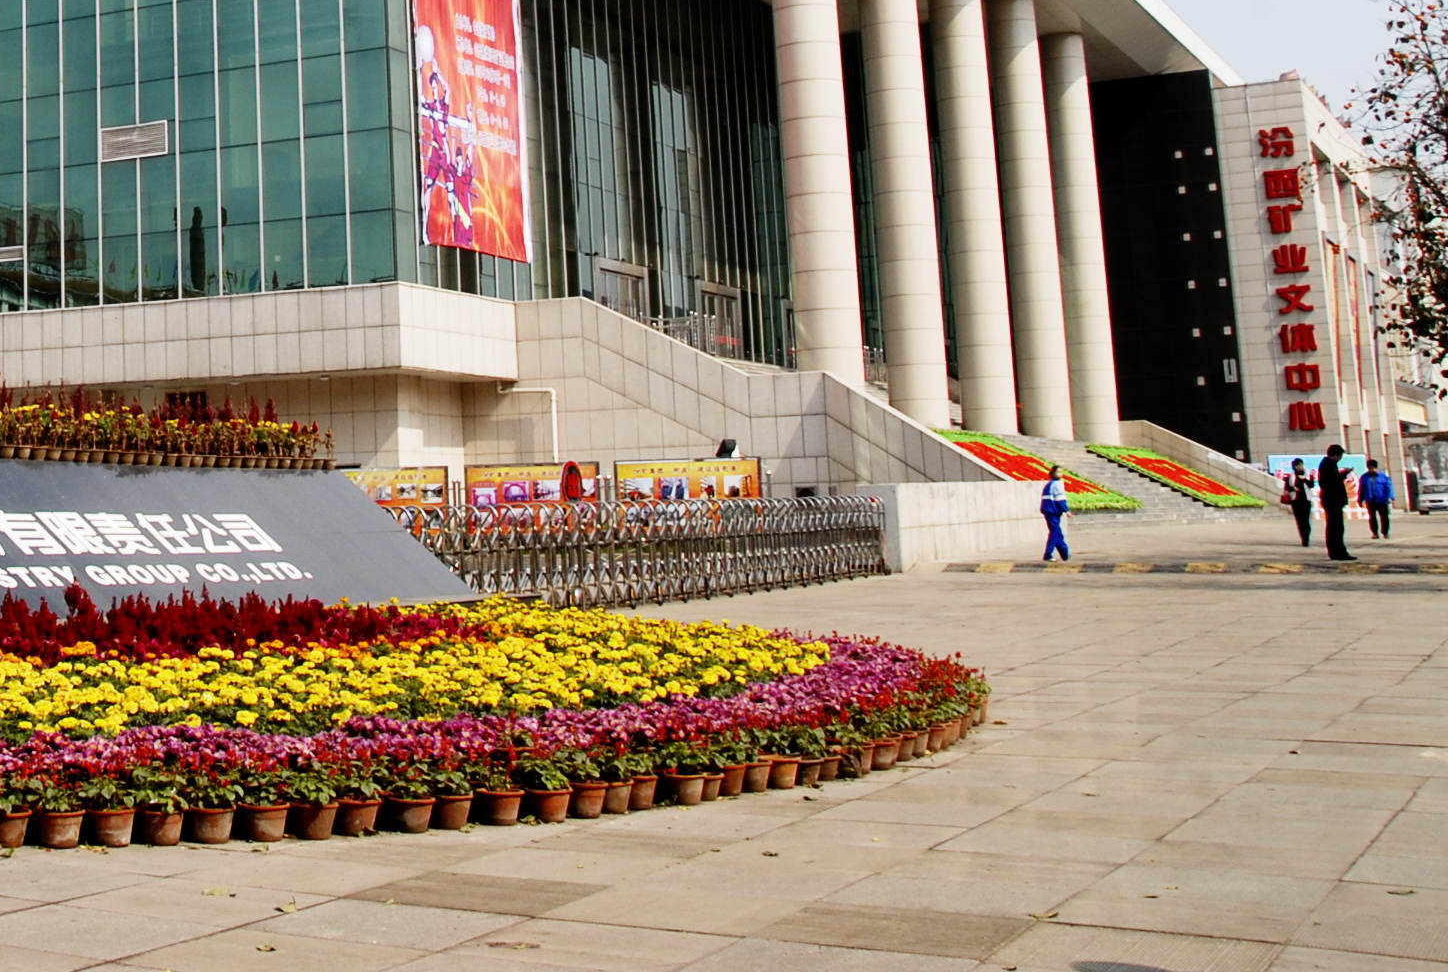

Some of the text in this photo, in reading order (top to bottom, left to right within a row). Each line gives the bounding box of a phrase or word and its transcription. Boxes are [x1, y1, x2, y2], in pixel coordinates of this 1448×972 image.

[1258, 126, 1325, 431] 汾西矿业文体中心
[85, 562, 192, 587] GROUP
